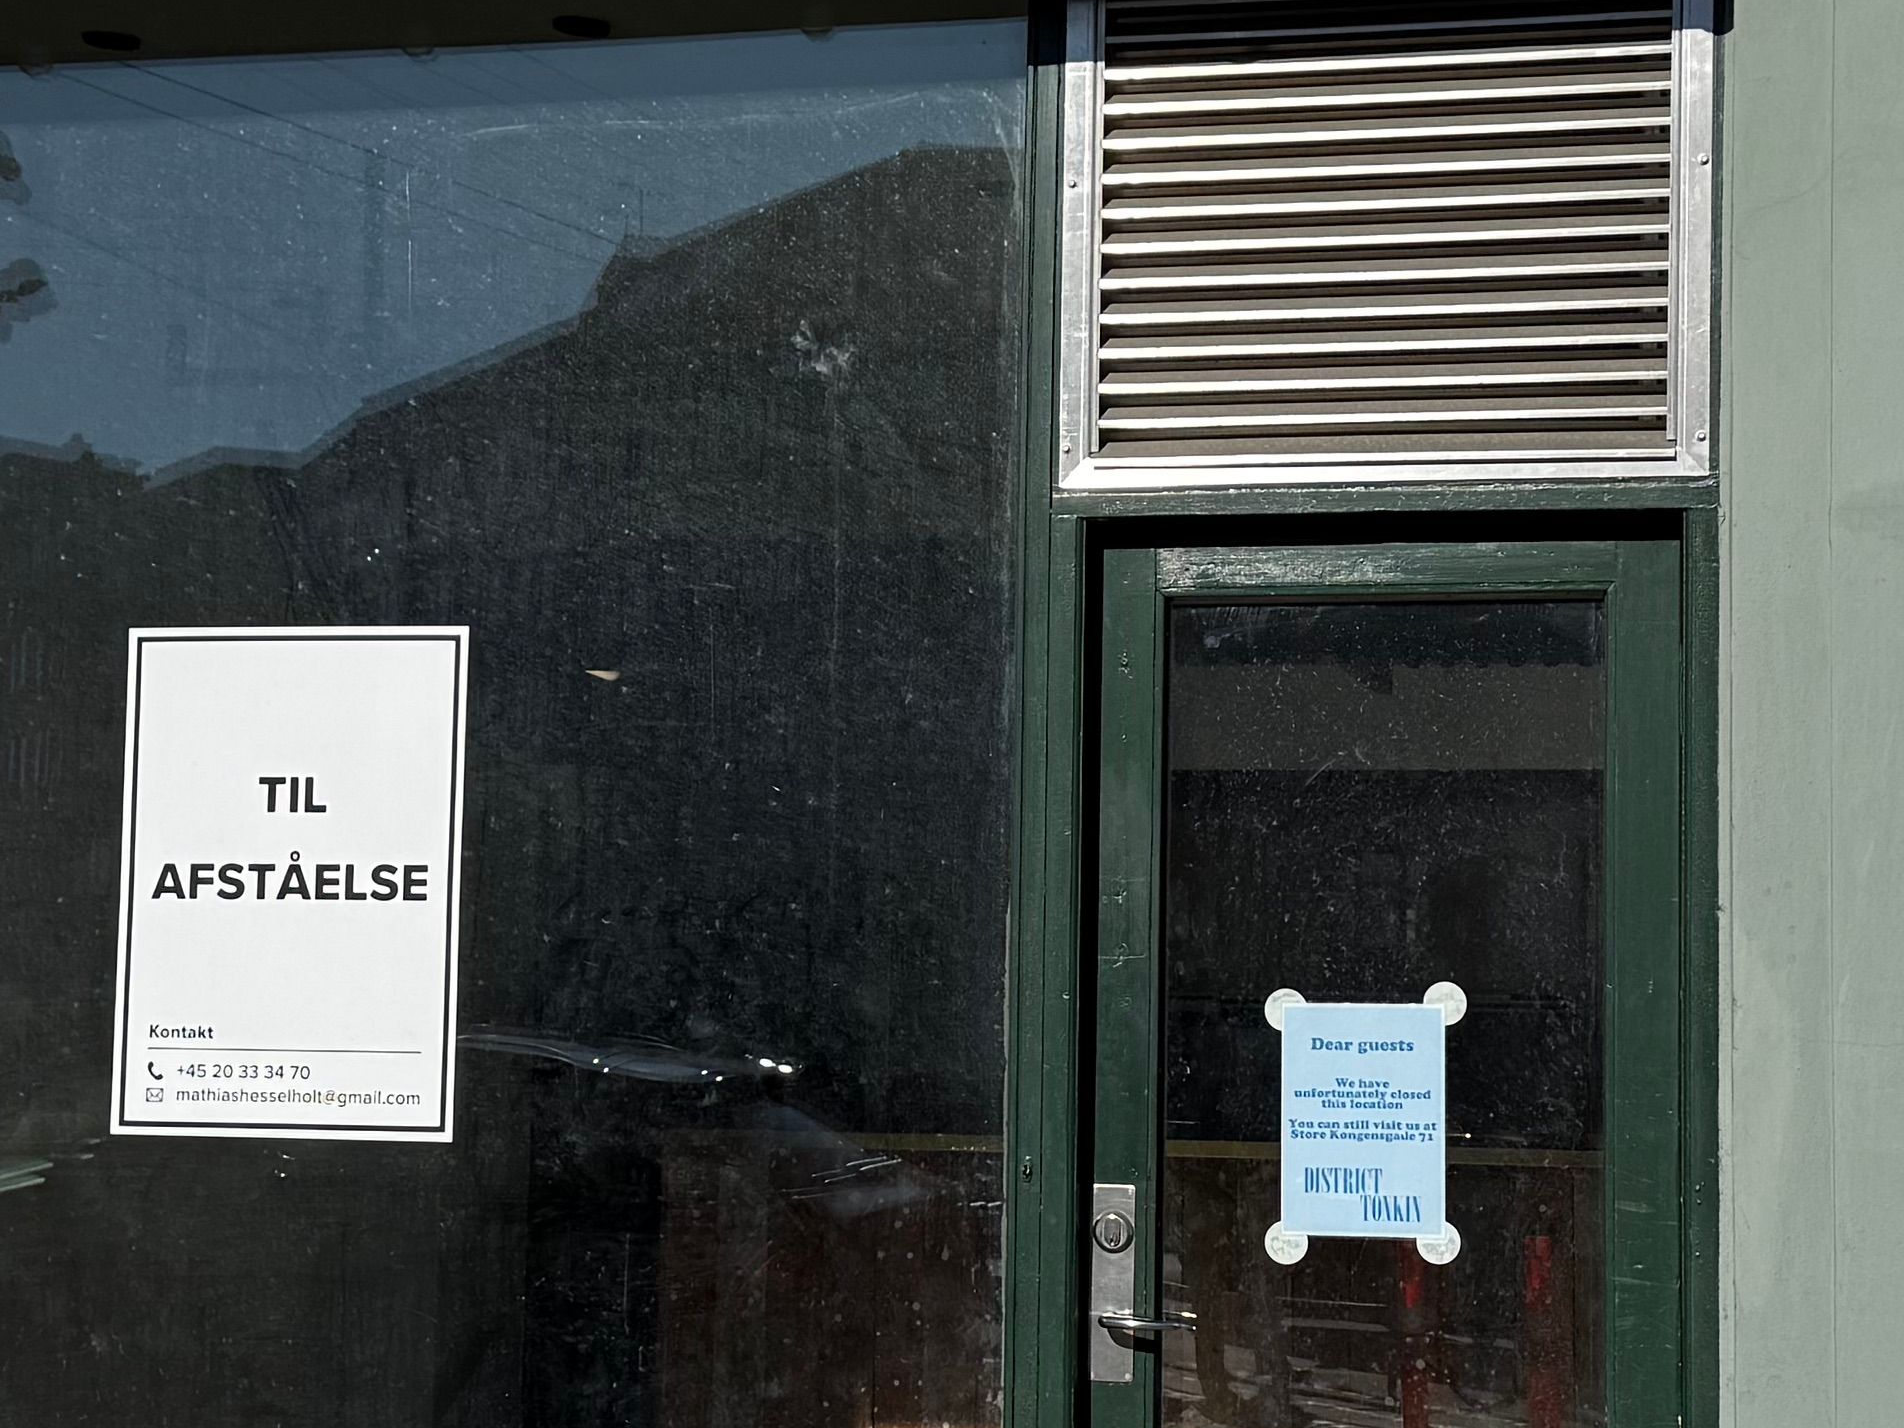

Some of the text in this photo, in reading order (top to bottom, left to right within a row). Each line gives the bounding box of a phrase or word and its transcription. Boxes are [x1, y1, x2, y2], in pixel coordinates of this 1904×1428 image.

[258, 776, 327, 814] TIL
[151, 850, 429, 902] AFSTÅELSE
[148, 1024, 214, 1040] Kontakt
[1310, 1037, 1415, 1055] Dear guests
[176, 1064, 311, 1080] +45 20 33 34 70
[1335, 1077, 1390, 1089] We have
[176, 1087, 421, 1108] mathiashesselholt@gmail.com
[1293, 1088, 1432, 1101] unfortunately closed
[1321, 1098, 1404, 1110] this location
[1288, 1118, 1438, 1131] You can still visit us at
[1290, 1128, 1327, 1140] Store
[1418, 1132, 1434, 1142] 71
[1304, 1166, 1383, 1194] DISTRICT
[1359, 1194, 1422, 1223] TONKIN
